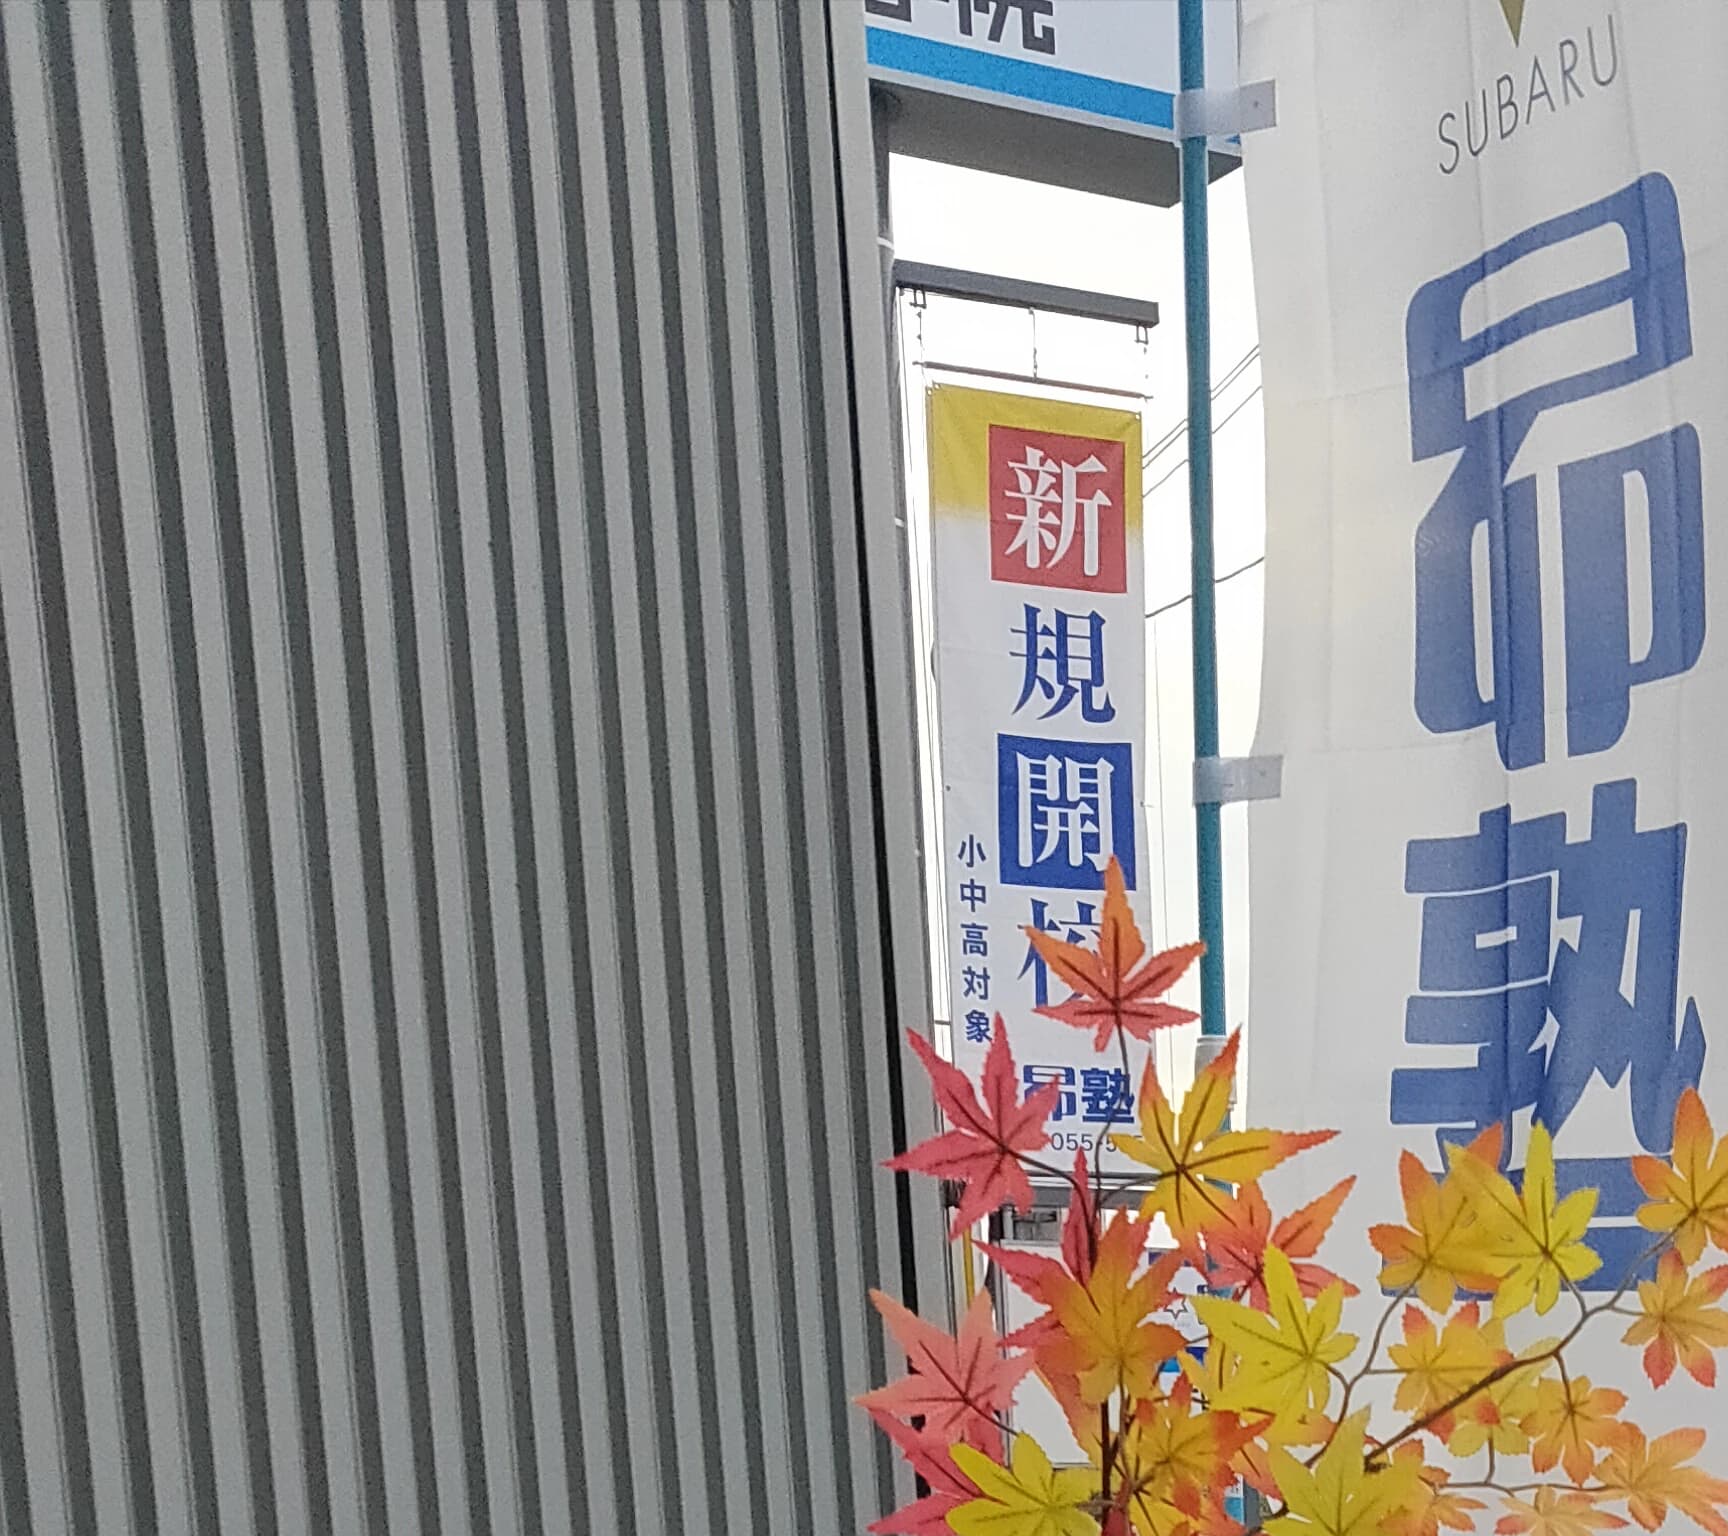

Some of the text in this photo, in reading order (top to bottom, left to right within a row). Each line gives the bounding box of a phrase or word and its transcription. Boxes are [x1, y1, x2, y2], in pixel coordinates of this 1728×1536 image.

[1438, 14, 1618, 174] SUBARU
[1380, 171, 1708, 1300] 昴塾
[957, 833, 994, 1043] 小中高対象
[1023, 1064, 1135, 1123] 昴塾
